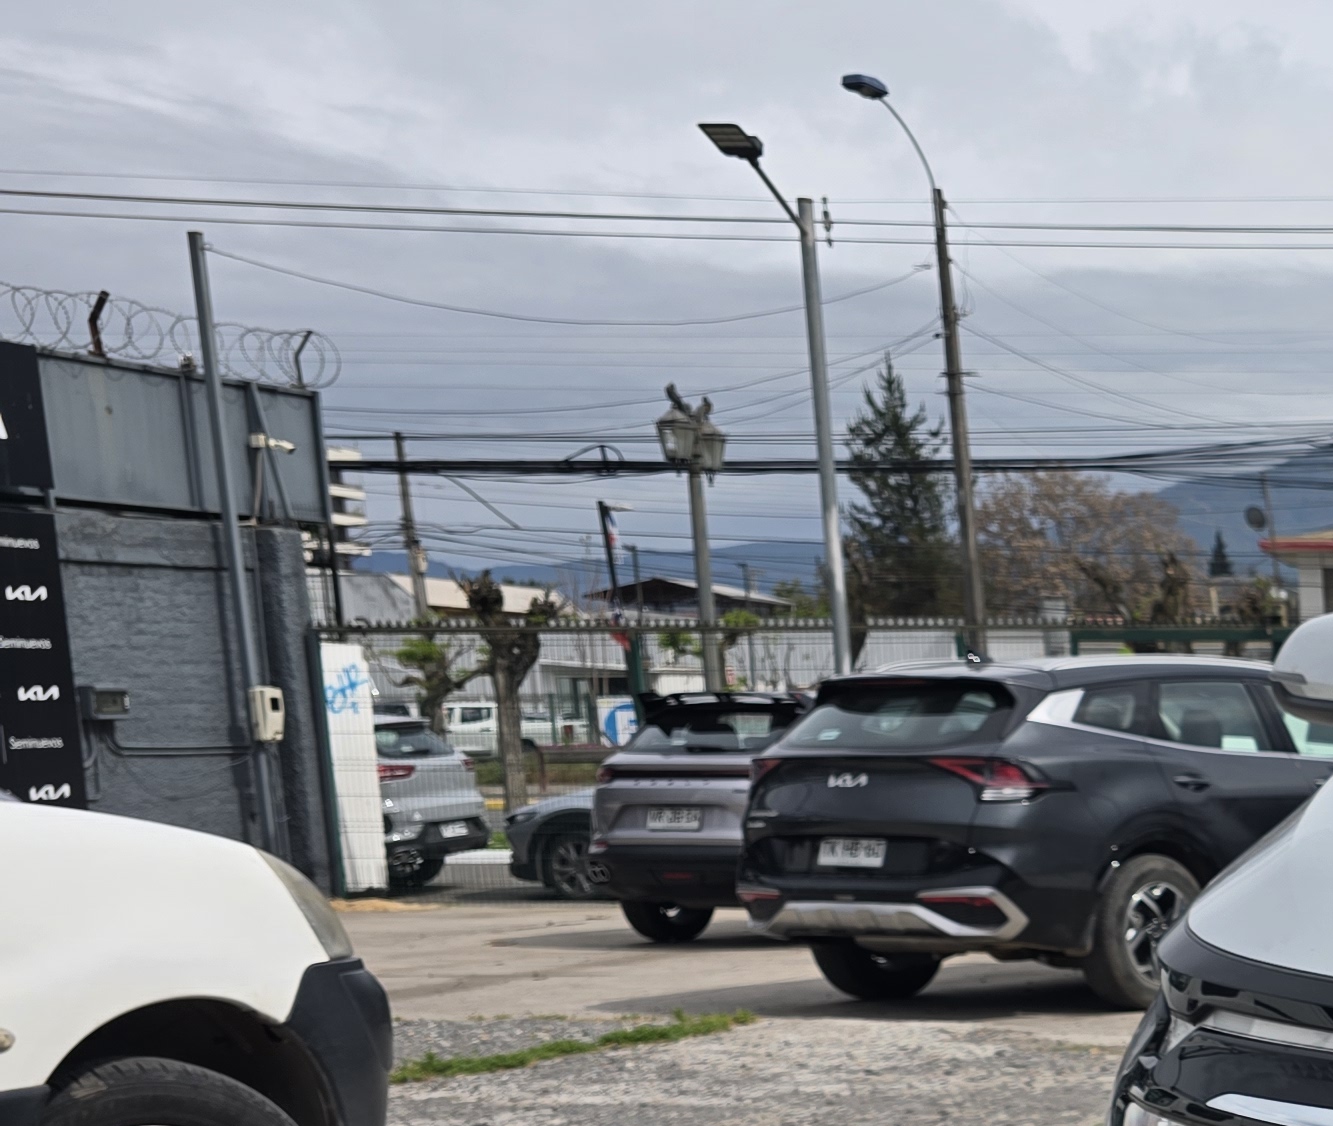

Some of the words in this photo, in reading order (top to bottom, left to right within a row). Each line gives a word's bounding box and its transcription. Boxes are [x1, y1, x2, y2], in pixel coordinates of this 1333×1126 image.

[5, 584, 48, 601] KIA
[17, 684, 60, 701] KIA
[827, 772, 869, 788] KIA
[29, 783, 71, 801] KIA
